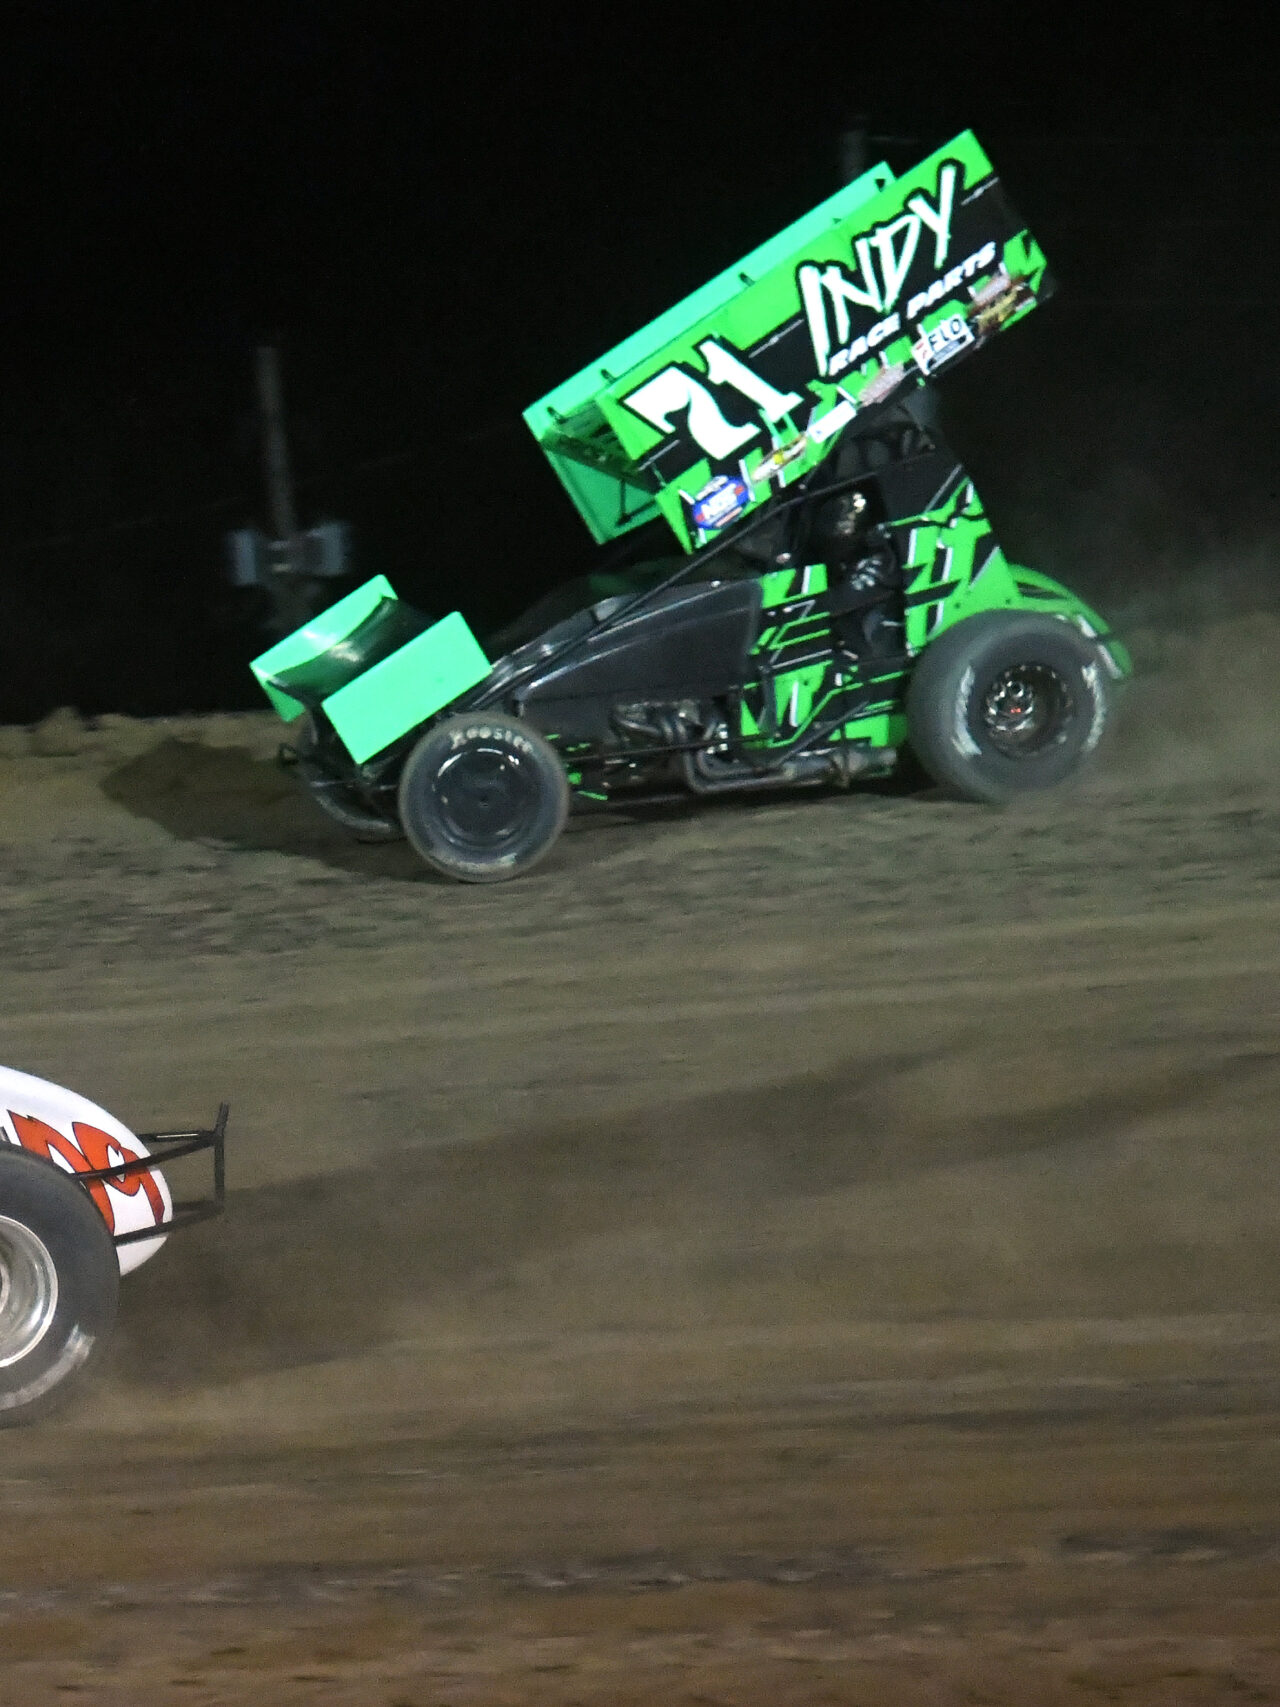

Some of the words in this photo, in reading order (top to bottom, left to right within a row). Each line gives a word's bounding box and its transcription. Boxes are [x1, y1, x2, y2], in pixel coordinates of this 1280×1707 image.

[800, 165, 956, 376] INDY
[829, 312, 900, 376] RACE
[907, 242, 996, 319] PARTS
[623, 340, 804, 460] 71
